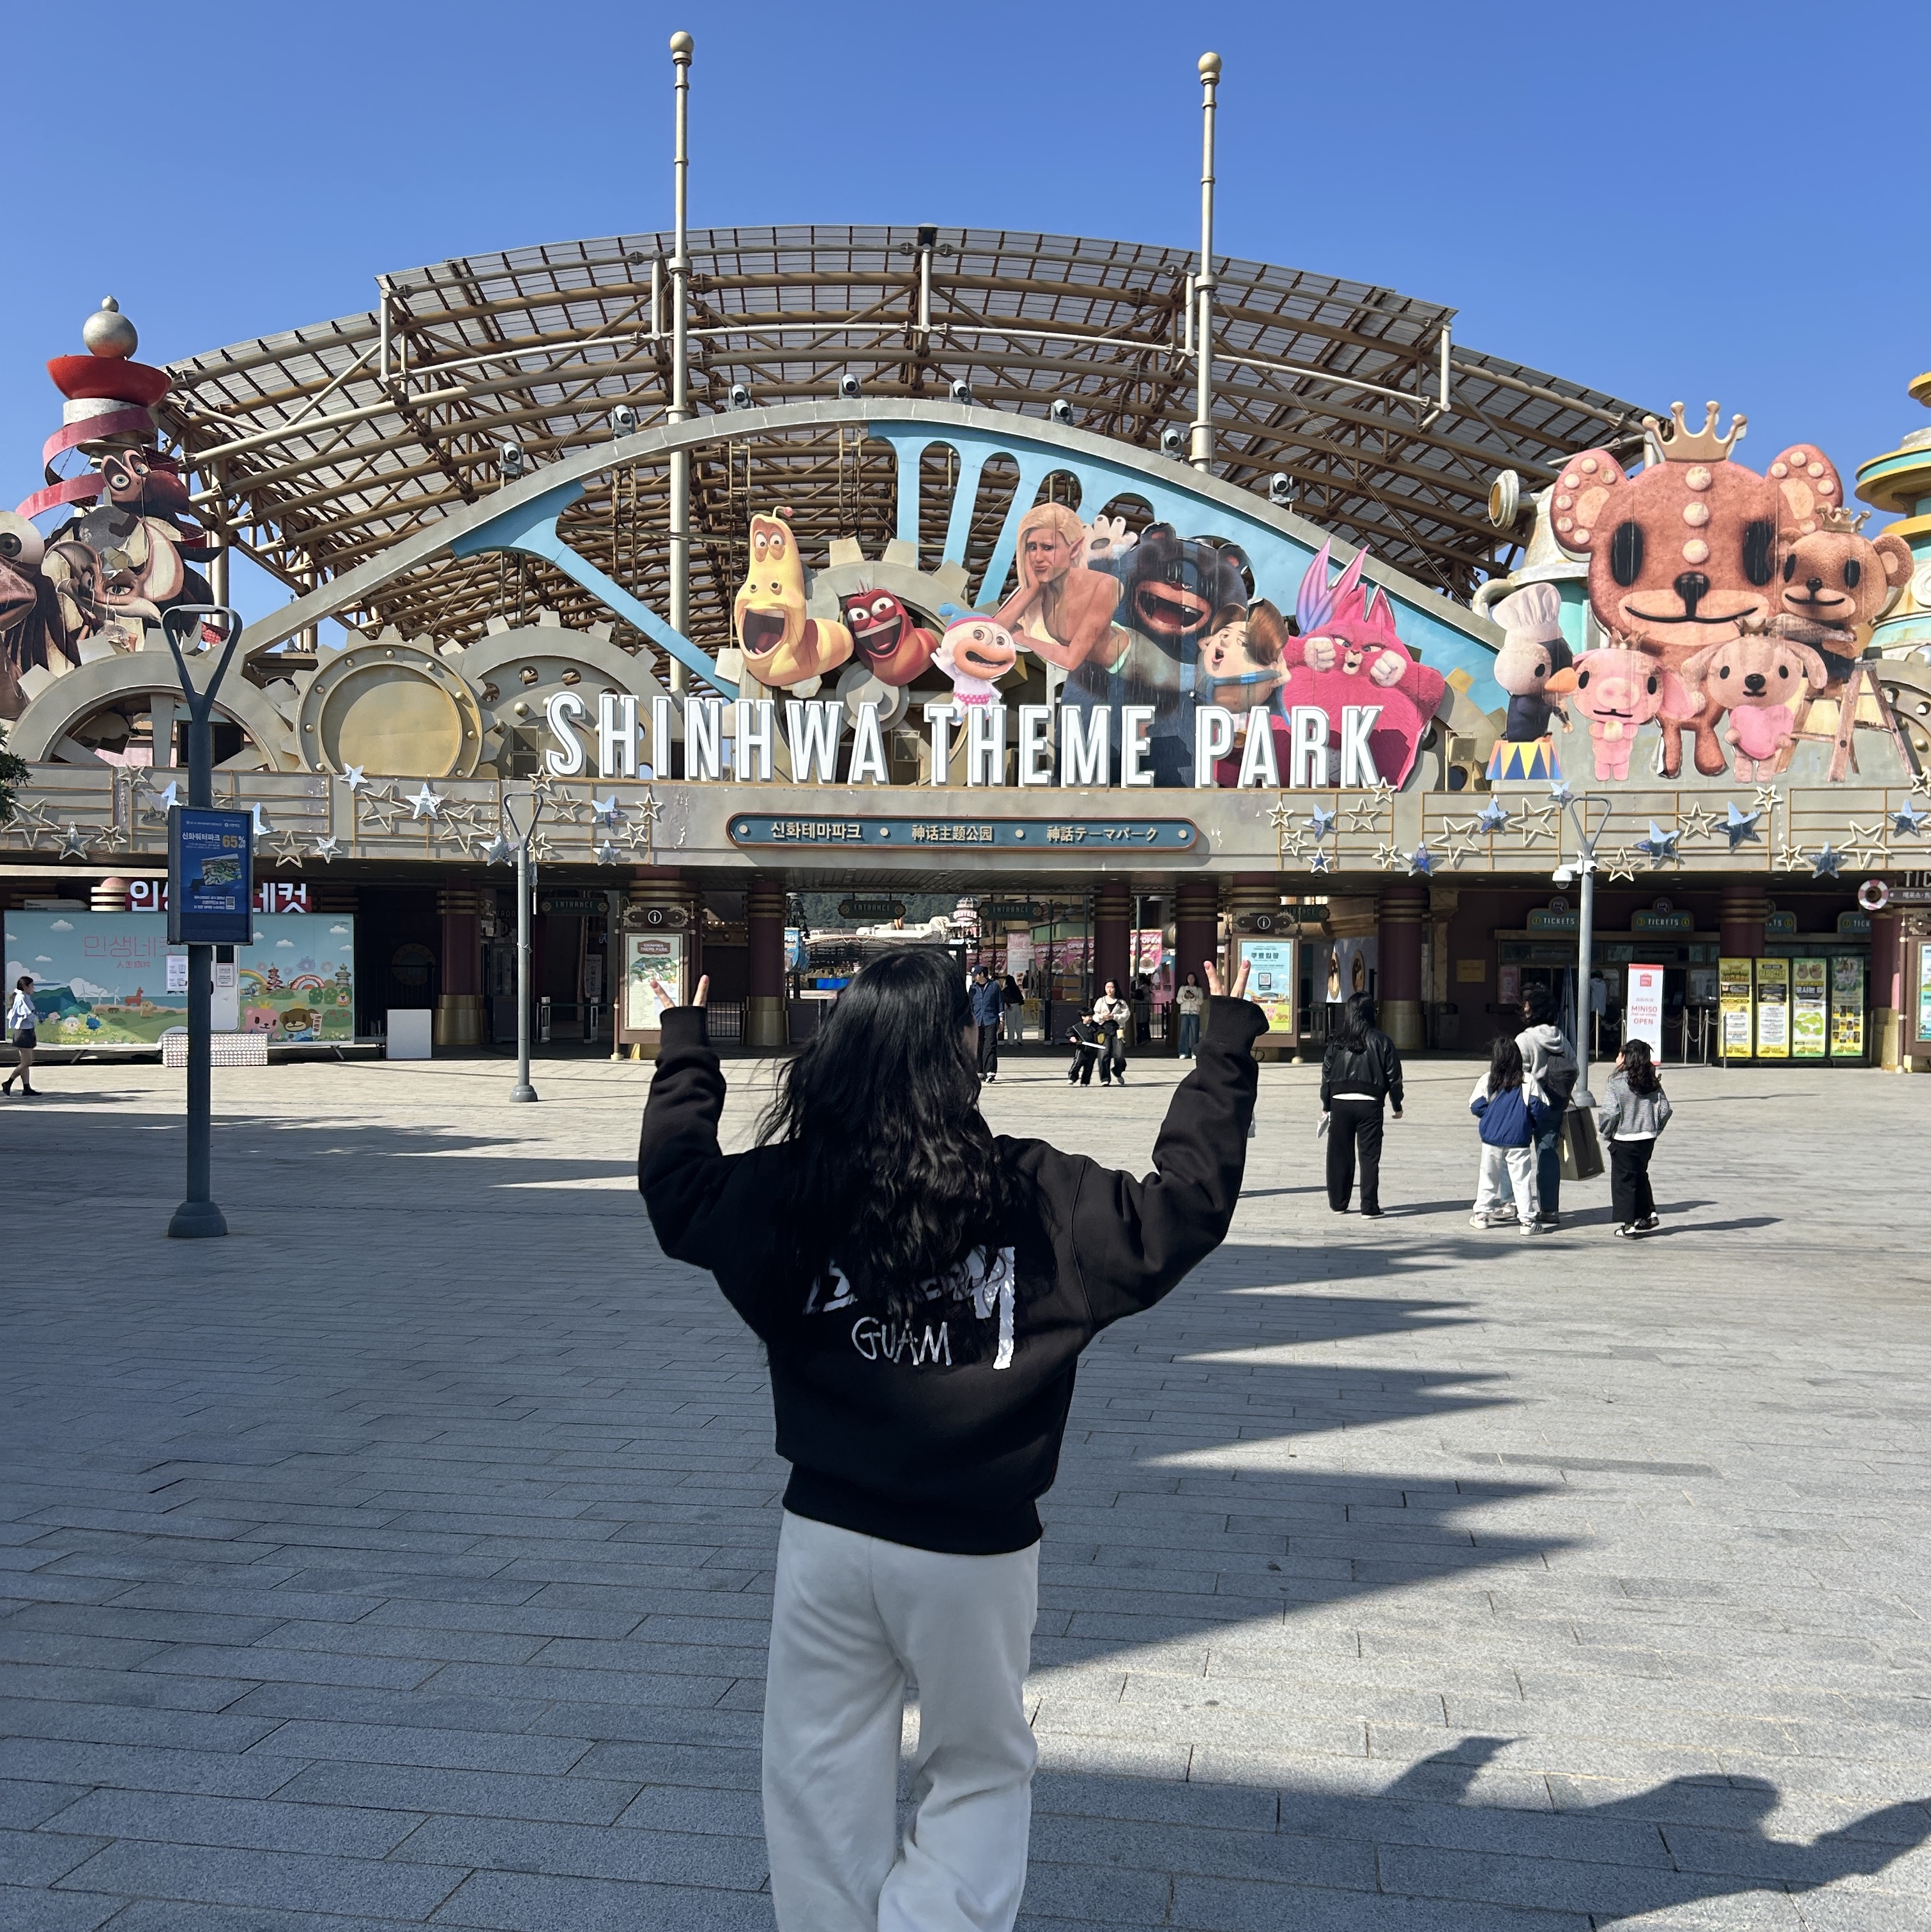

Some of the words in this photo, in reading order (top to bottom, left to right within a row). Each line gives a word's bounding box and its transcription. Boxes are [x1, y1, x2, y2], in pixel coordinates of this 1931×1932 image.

[546, 691, 890, 786] SHINHWA
[924, 704, 1156, 789] THEME
[1196, 705, 1384, 789] PARK
[770, 821, 862, 839] 신화테마파크
[912, 825, 993, 842] 神话主题公园
[1047, 825, 1158, 842] 神話テーマパーク
[1648, 918, 1679, 926] TICKETS
[1631, 1005, 1658, 1013] MINISO
[851, 1316, 952, 1366] GUAM
